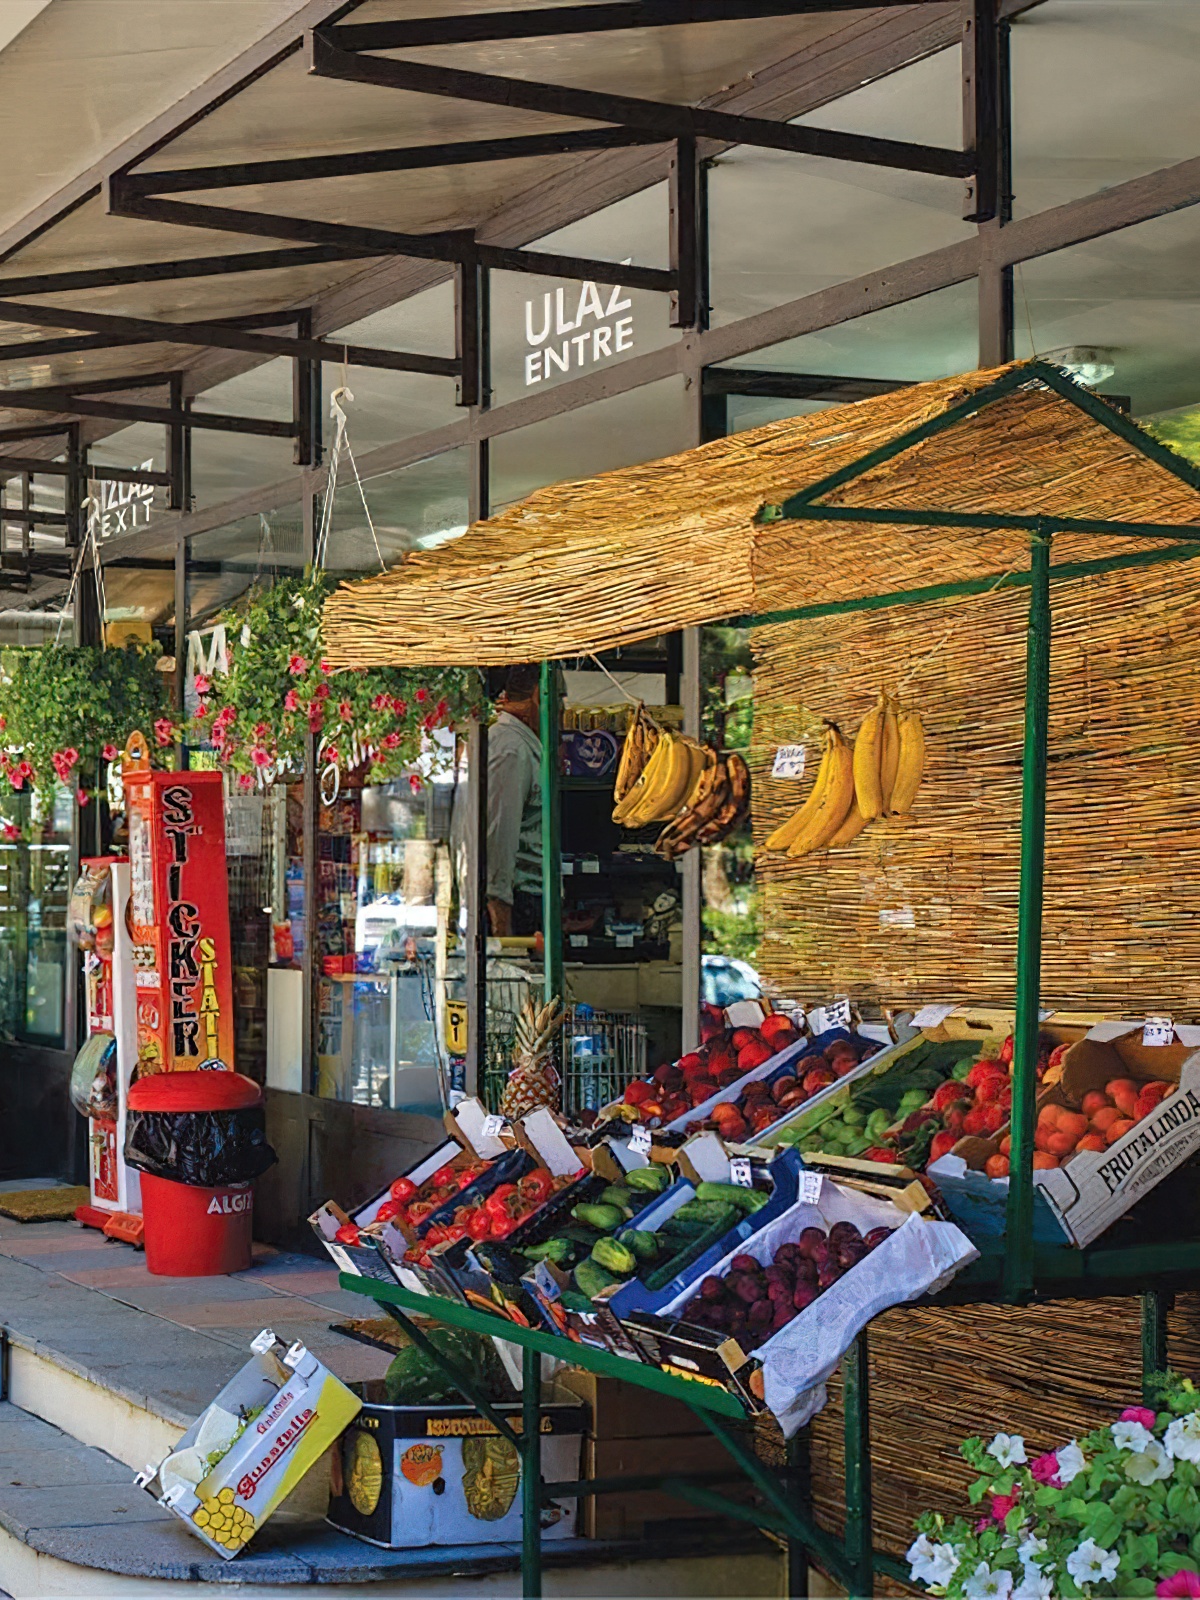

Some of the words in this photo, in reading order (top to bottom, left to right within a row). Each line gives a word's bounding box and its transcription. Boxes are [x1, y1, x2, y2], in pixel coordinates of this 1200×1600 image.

[525, 257, 632, 346] ULAZ
[525, 316, 634, 386] ENTRE
[101, 496, 155, 538] EXIT
[162, 785, 204, 1058] STICKER
[1096, 1088, 1200, 1197] FRUTALINDA
